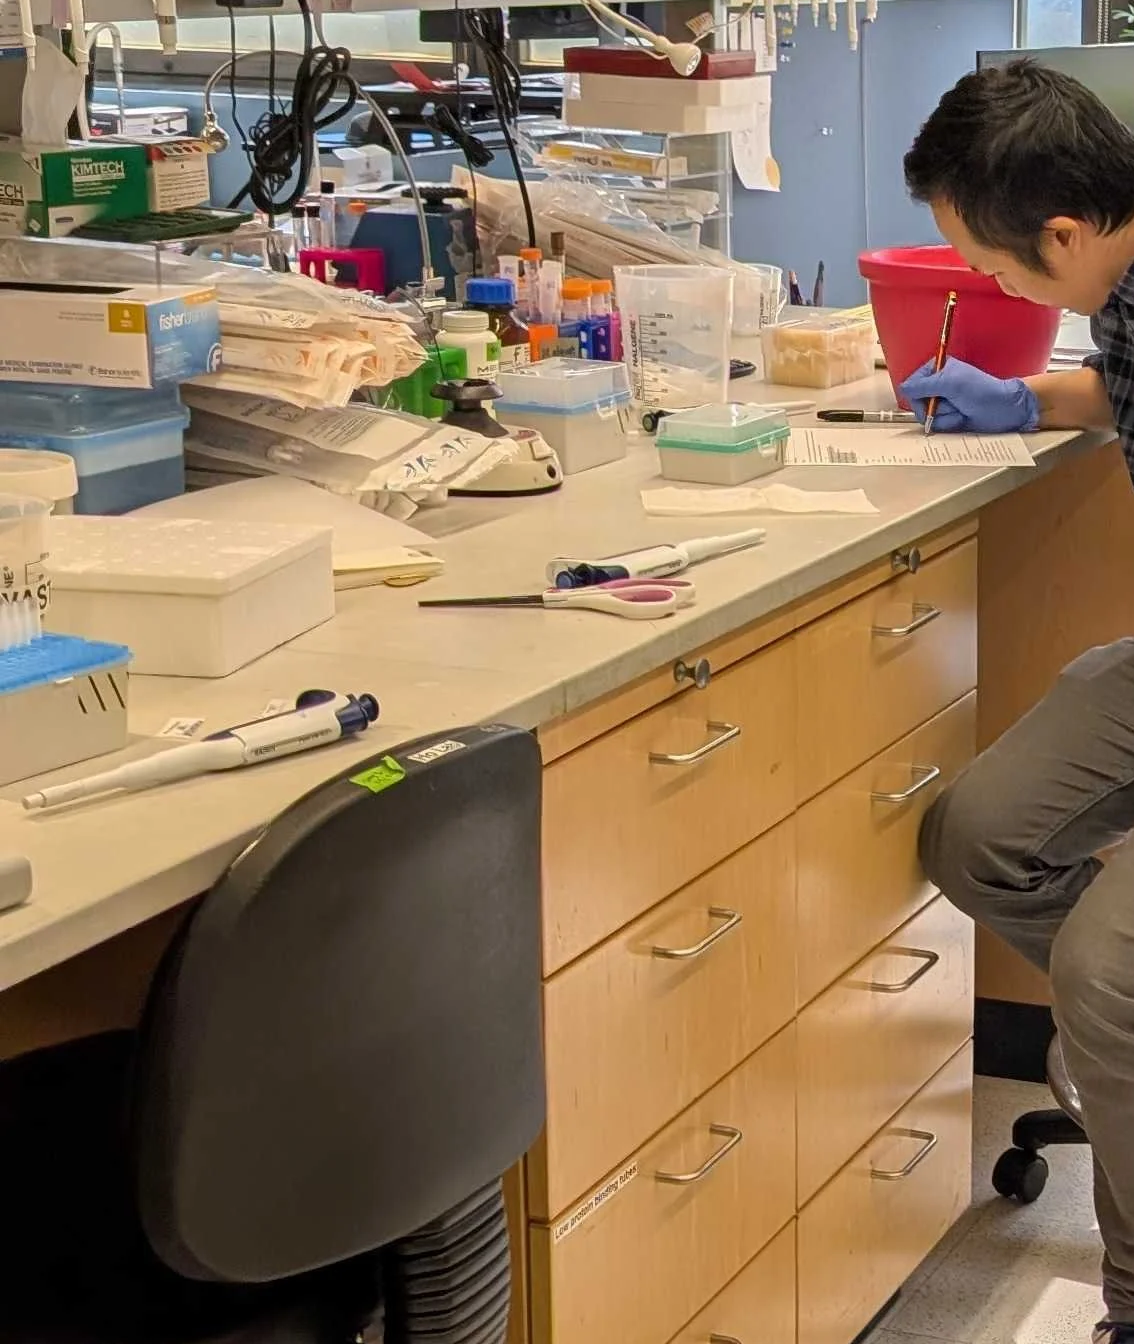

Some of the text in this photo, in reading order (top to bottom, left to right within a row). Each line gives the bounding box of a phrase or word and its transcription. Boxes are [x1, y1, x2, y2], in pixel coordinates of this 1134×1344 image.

[71, 160, 124, 176] KIMTECH
[629, 320, 638, 367] NALGENE
[555, 1164, 638, 1239] Low protein binding tubes
